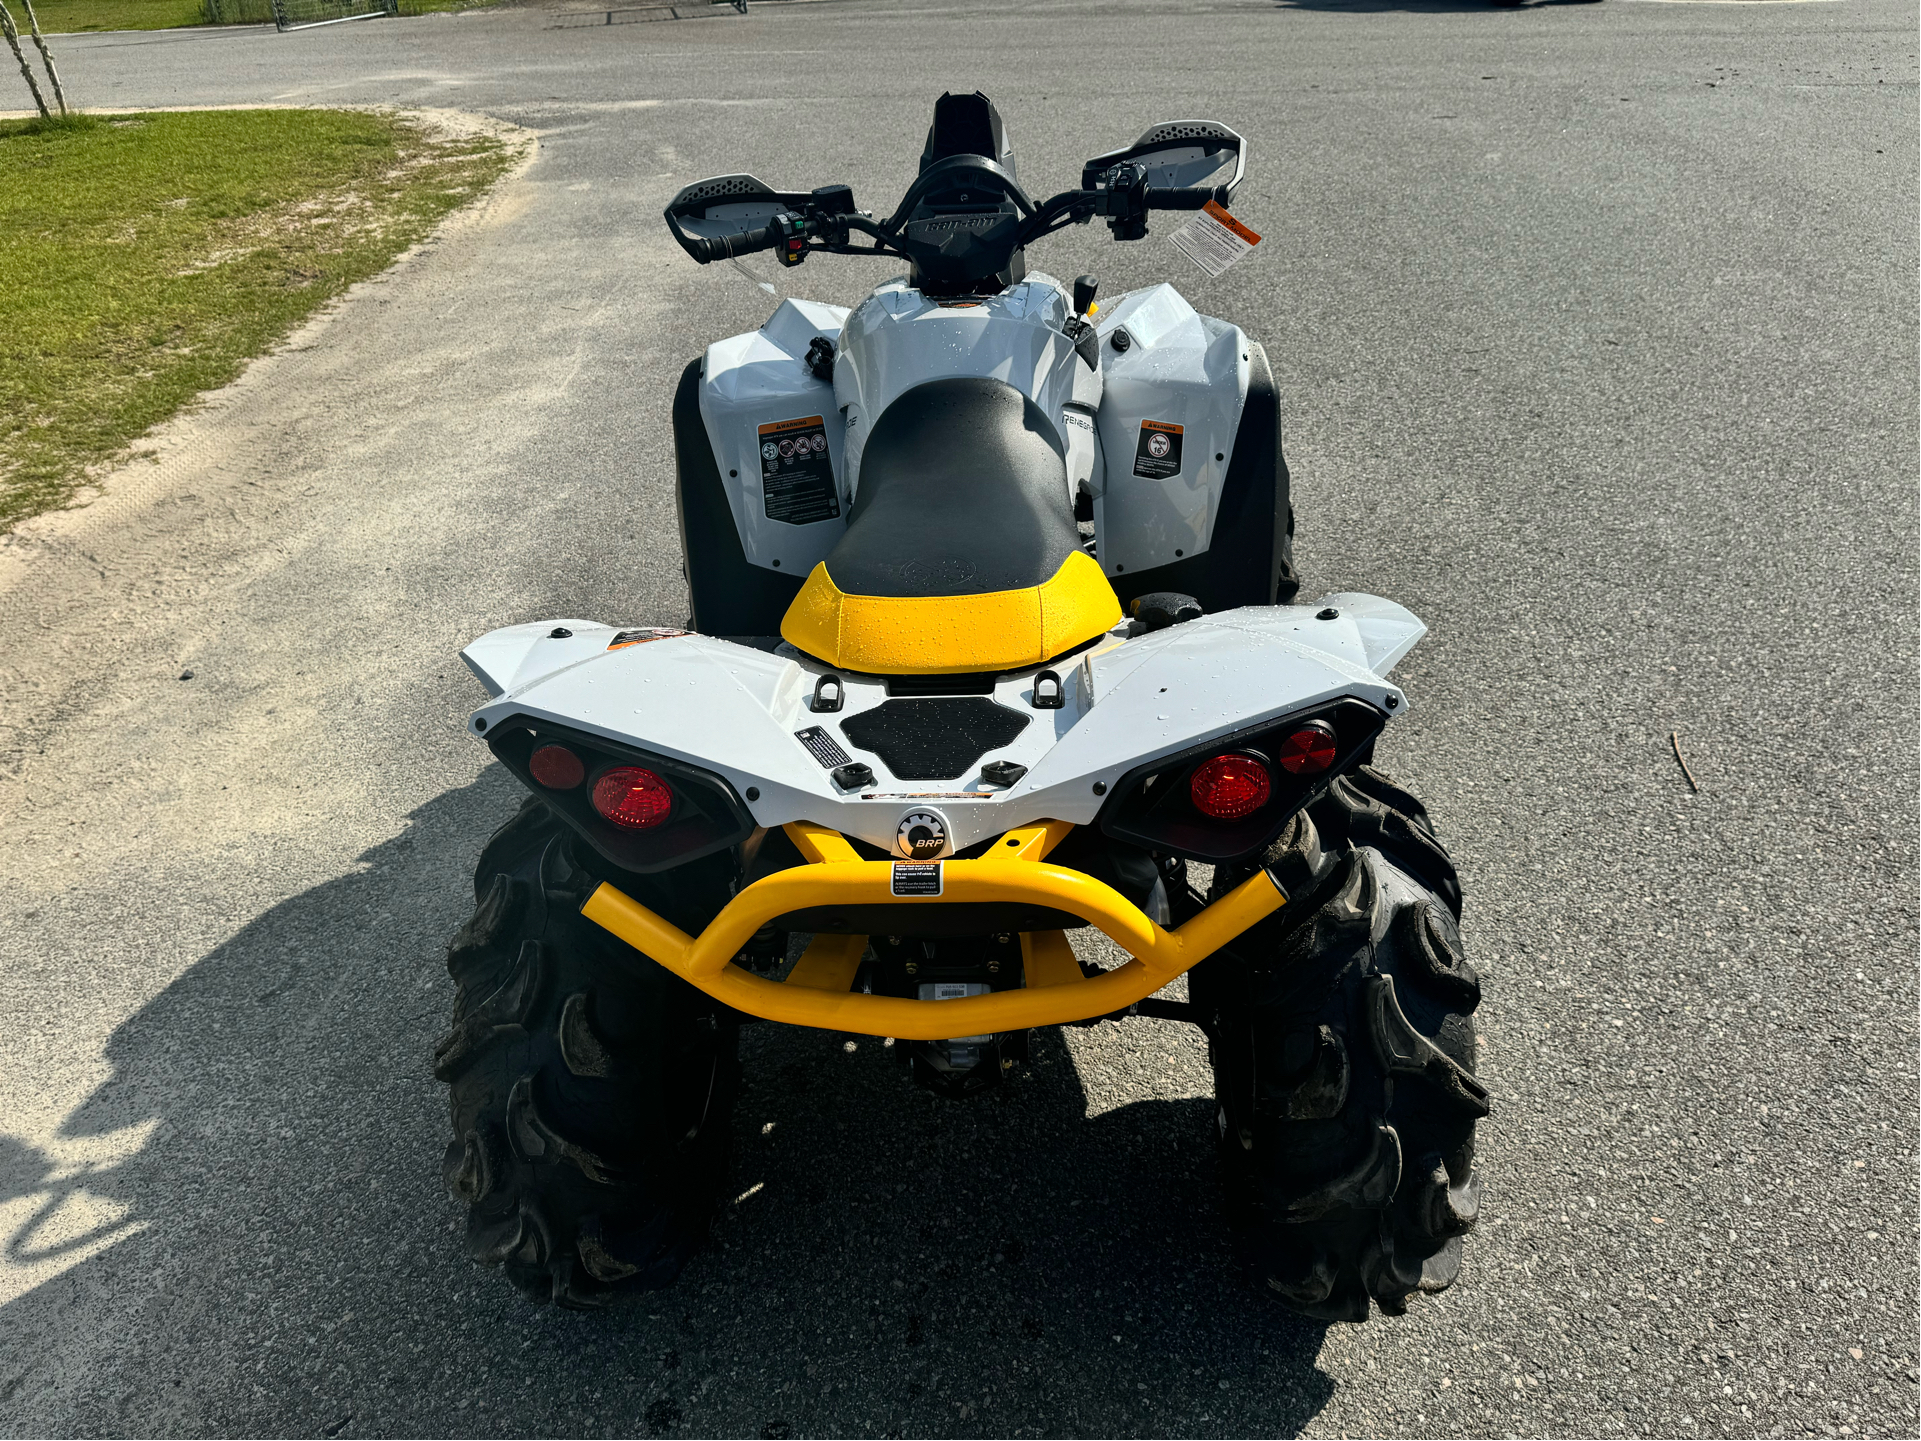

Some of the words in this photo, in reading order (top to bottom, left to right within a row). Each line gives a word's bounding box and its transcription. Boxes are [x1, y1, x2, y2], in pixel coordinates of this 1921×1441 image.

[1209, 209, 1231, 226] SPORT
[1230, 225, 1251, 242] MODEL
[781, 420, 807, 429] WARNING
[1152, 423, 1176, 432] WARNING
[916, 839, 944, 848] BRP
